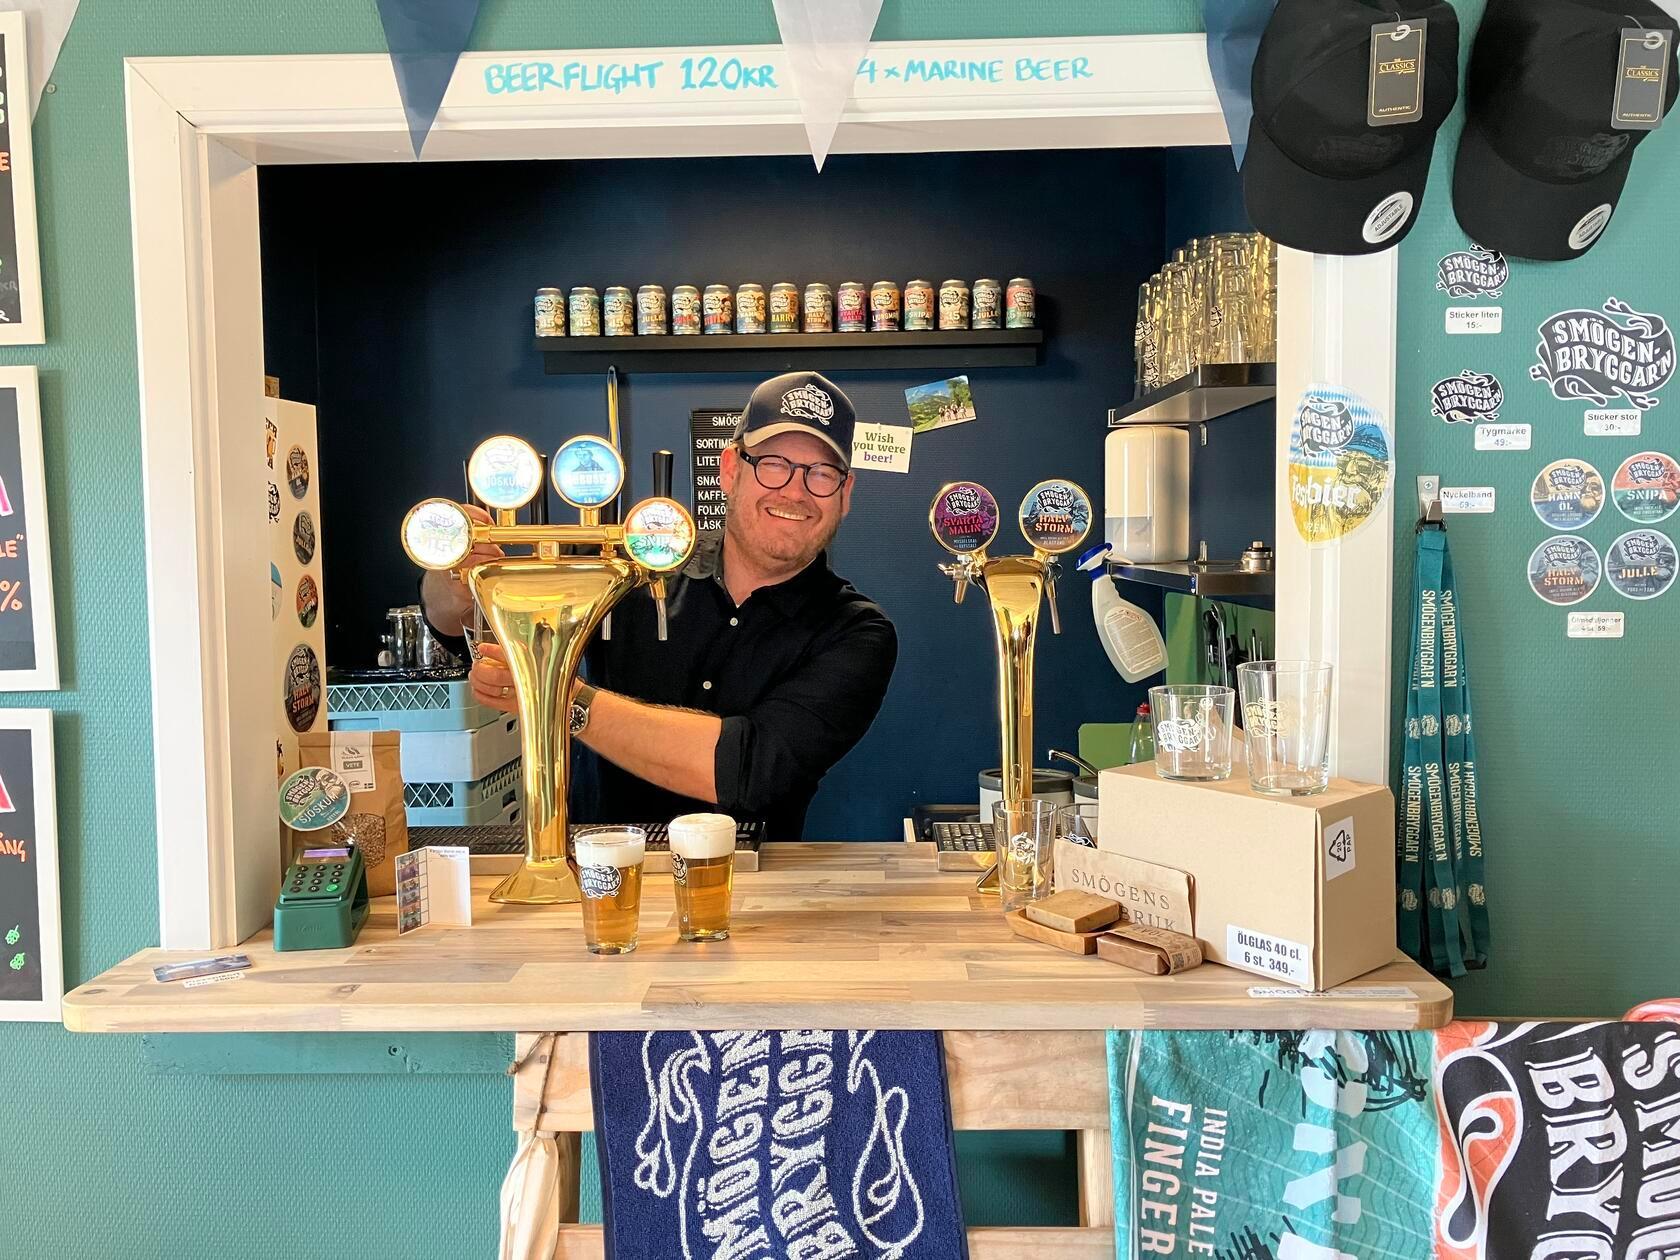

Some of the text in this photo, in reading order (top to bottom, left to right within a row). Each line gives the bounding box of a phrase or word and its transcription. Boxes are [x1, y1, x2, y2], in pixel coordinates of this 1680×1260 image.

[1380, 61, 1415, 72] CLASSICS
[680, 57, 778, 90] 120KR
[904, 59, 1004, 83] MARINE
[1015, 57, 1094, 81] BEER
[1449, 311, 1499, 319] Sticker liten
[712, 413, 741, 426] SMÖGE
[1588, 412, 1638, 421] Sticker stor
[865, 431, 894, 444] Wish
[853, 441, 906, 454] you were
[863, 452, 893, 464] beer!
[697, 475, 721, 486] SNAC
[1443, 491, 1493, 500] Nyckelband
[1626, 488, 1669, 500] SNIPA
[697, 503, 727, 515] FOLKÖ
[943, 514, 983, 527] SVARTA
[949, 523, 981, 535] MALIN
[1035, 522, 1073, 534] STORM
[1618, 566, 1659, 578] JULLE
[1543, 577, 1585, 587] STORM
[1420, 590, 1436, 688] SMÖGENBRYGGAR'N
[299, 792, 339, 824] SJÖSKUM
[1425, 763, 1448, 862] SMÖGENBRYGGAR'N
[1072, 868, 1170, 910] SMÖGENS
[1237, 931, 1302, 961] ÖLGLAS 40 cl.
[1244, 951, 1251, 964] 6
[1269, 958, 1295, 977] 349,-
[1188, 1107, 1228, 1257] INDIA PALE
